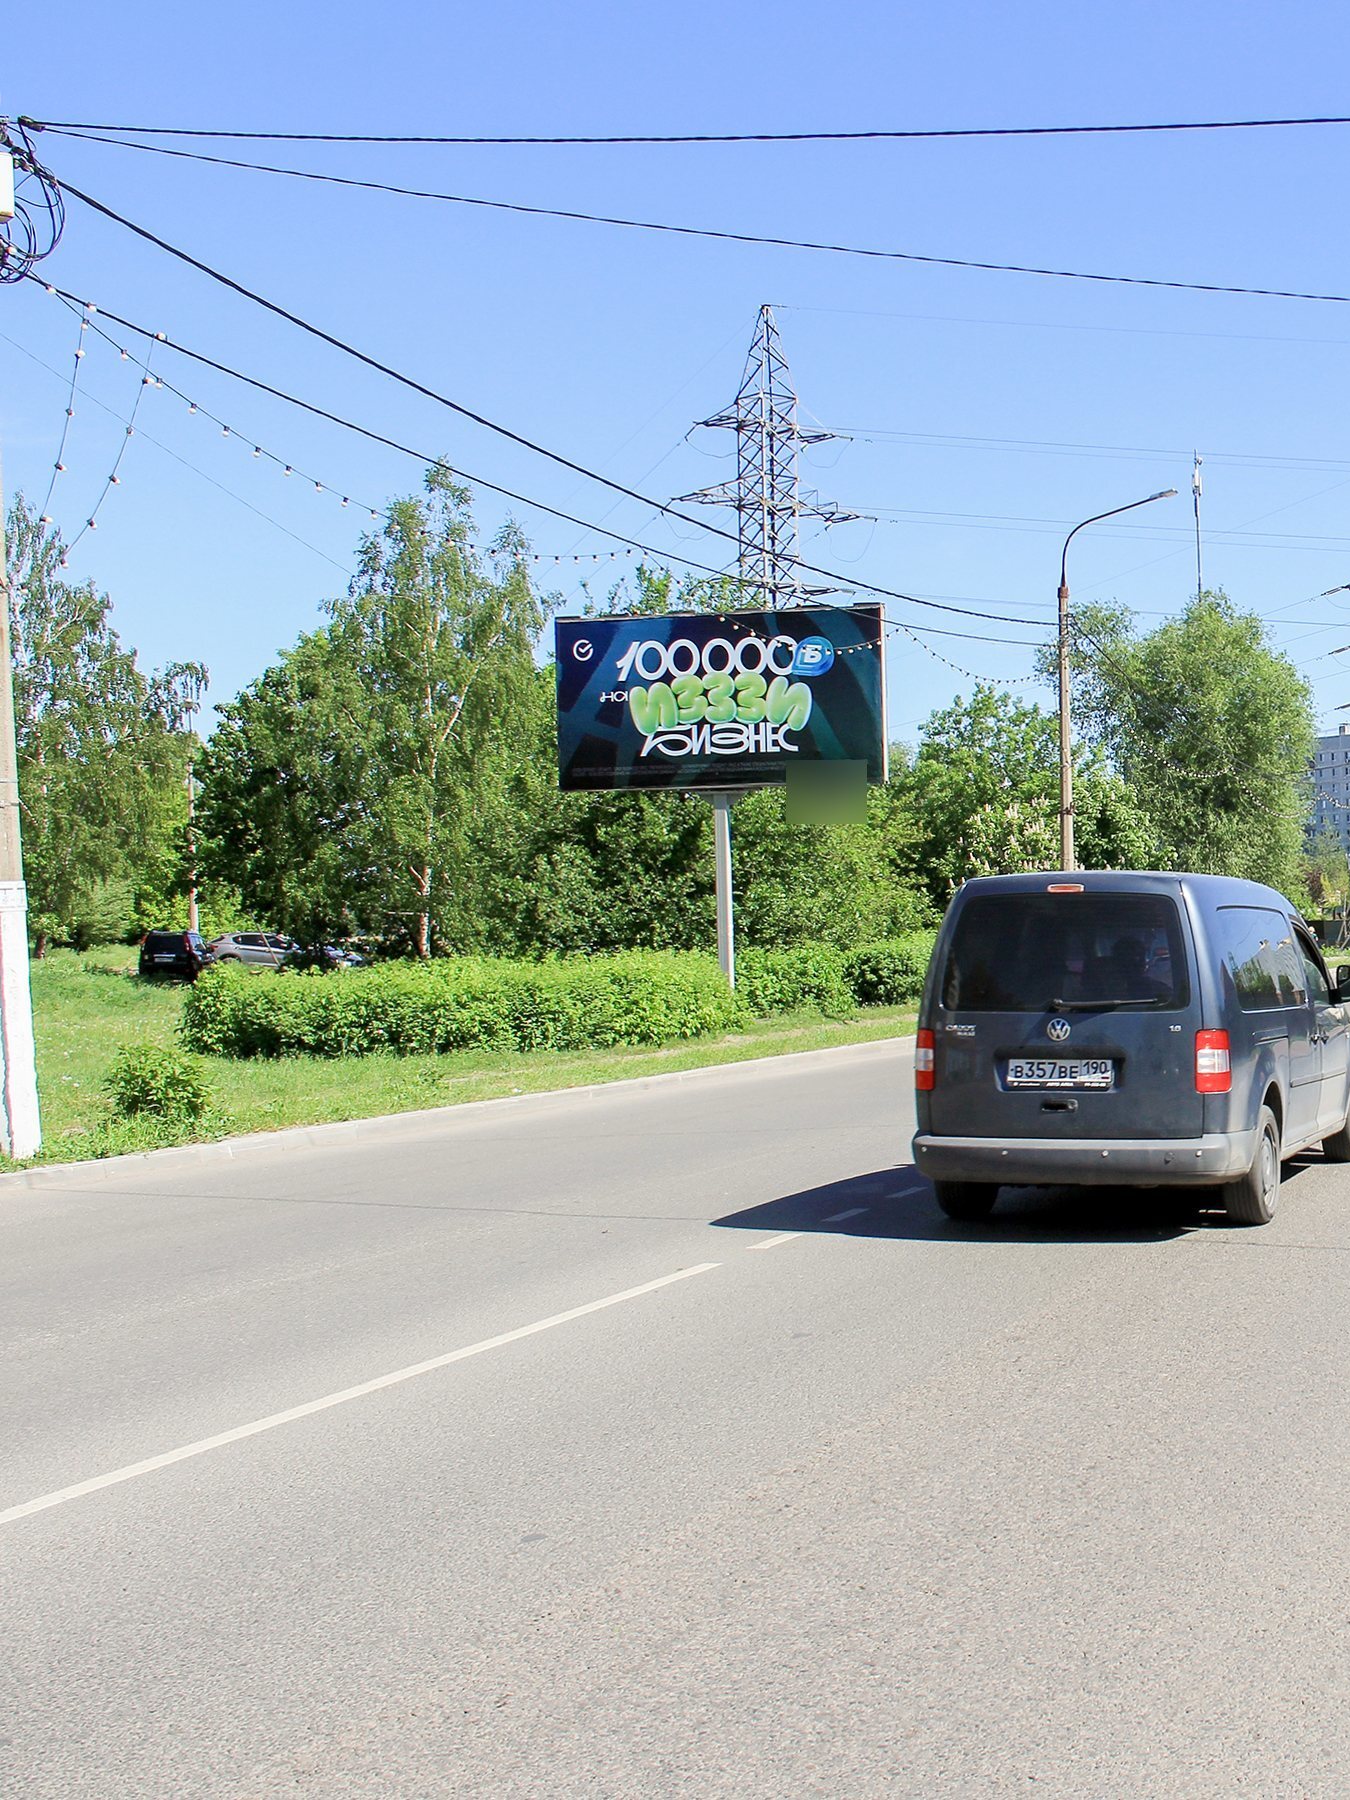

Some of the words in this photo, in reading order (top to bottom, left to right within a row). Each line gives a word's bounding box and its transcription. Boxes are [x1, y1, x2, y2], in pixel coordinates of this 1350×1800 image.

[600, 691, 629, 703] на
[640, 722, 799, 757] БИЗНЕС
[1083, 1061, 1108, 1074] 190
